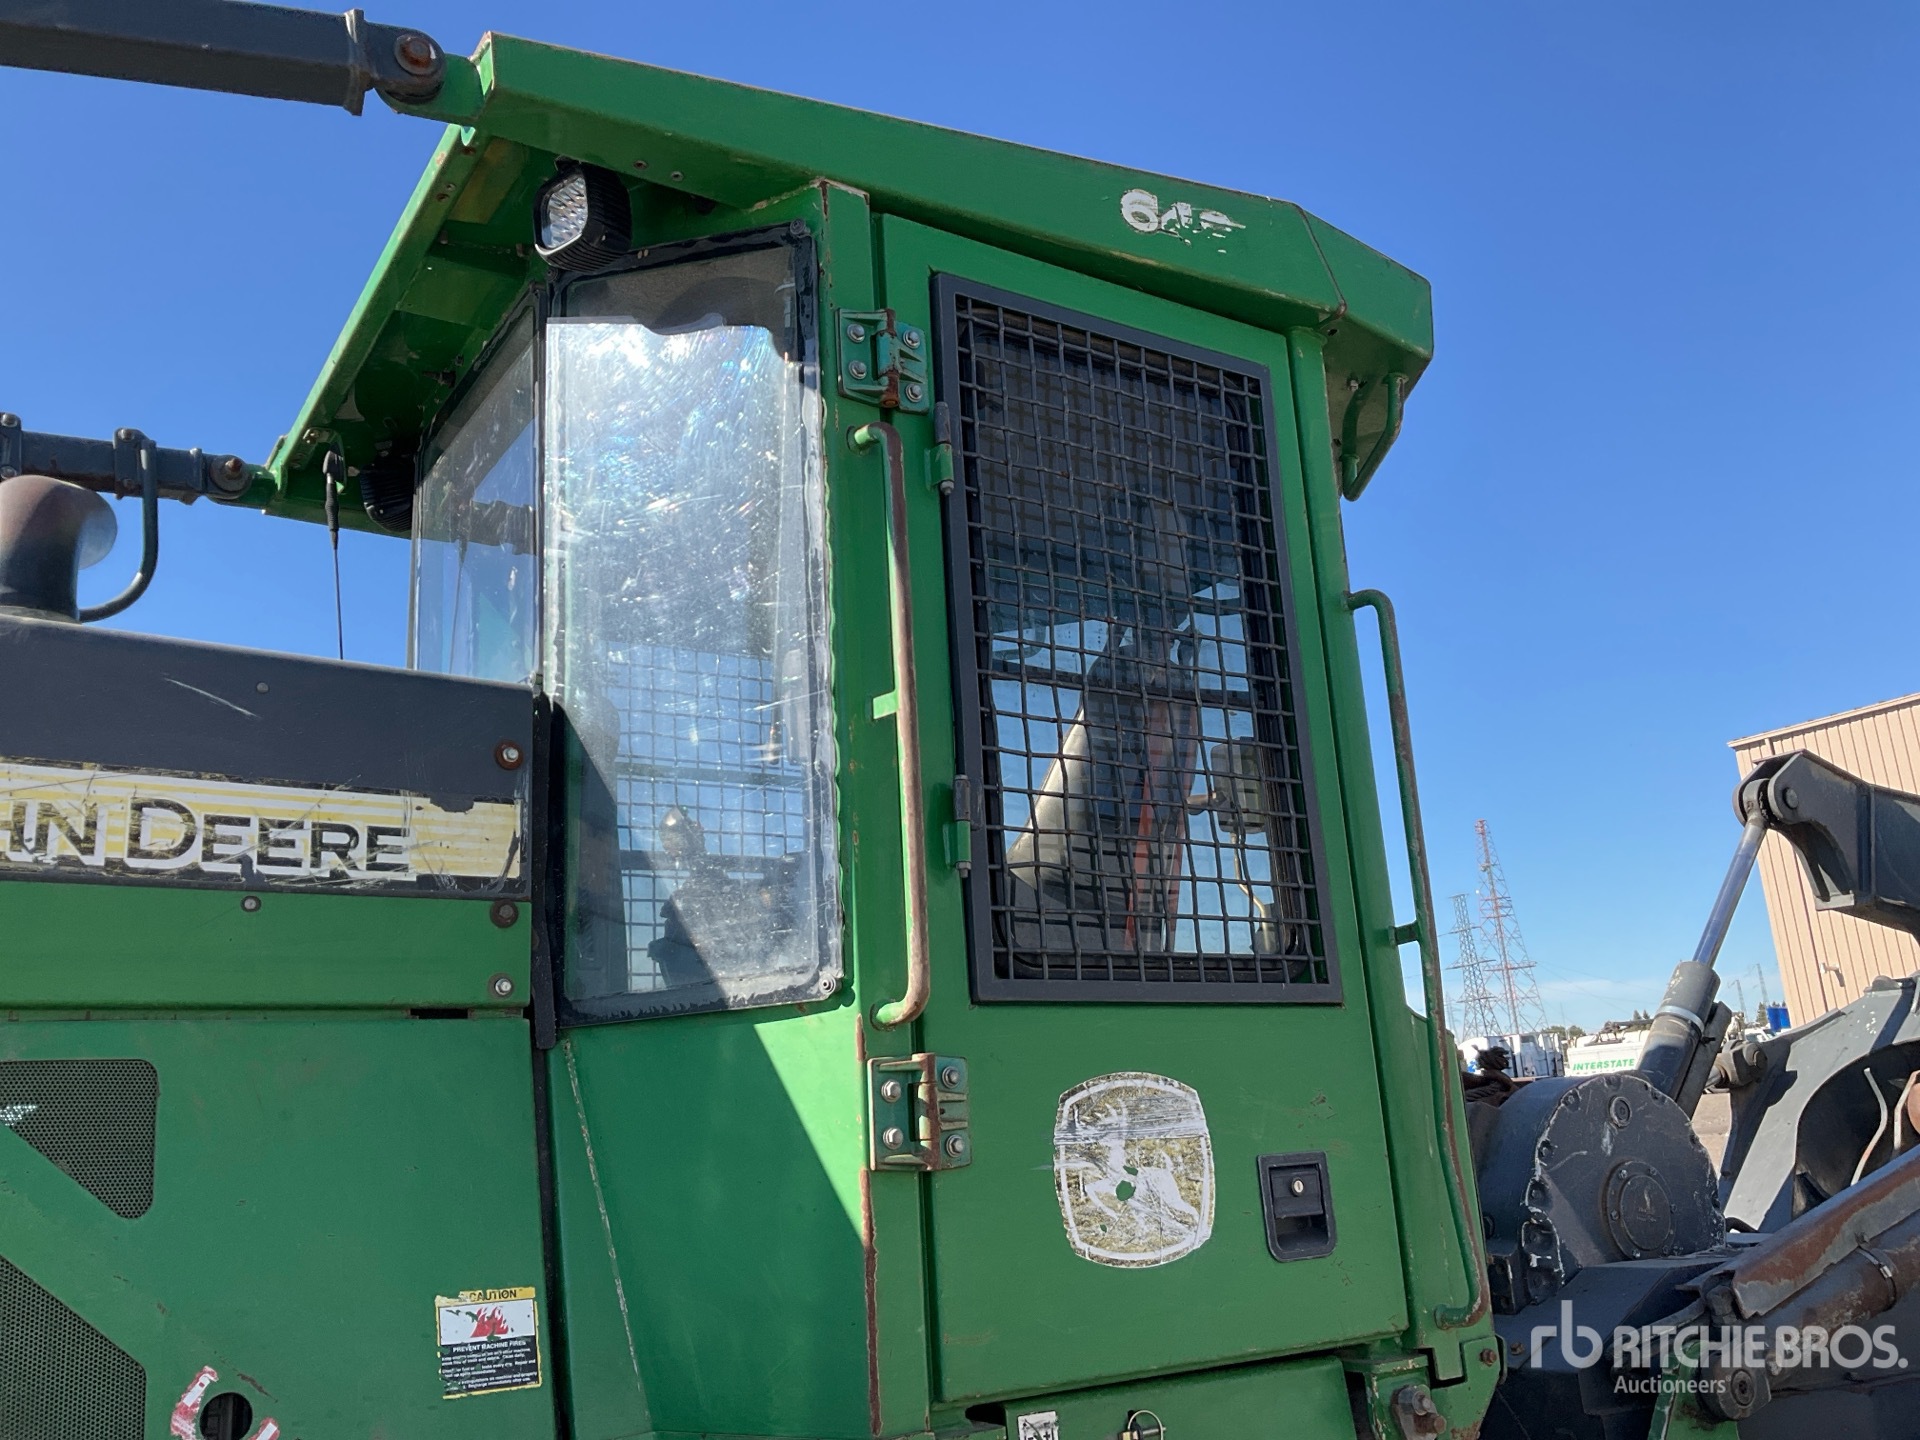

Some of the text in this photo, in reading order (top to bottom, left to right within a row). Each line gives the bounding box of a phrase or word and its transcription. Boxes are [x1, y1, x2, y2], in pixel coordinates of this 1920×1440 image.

[126, 797, 411, 874] DEERE
[1572, 1057, 1636, 1072] INTERSTATE
[469, 1289, 517, 1302] CAUTION
[452, 1343, 481, 1353] PREVENT
